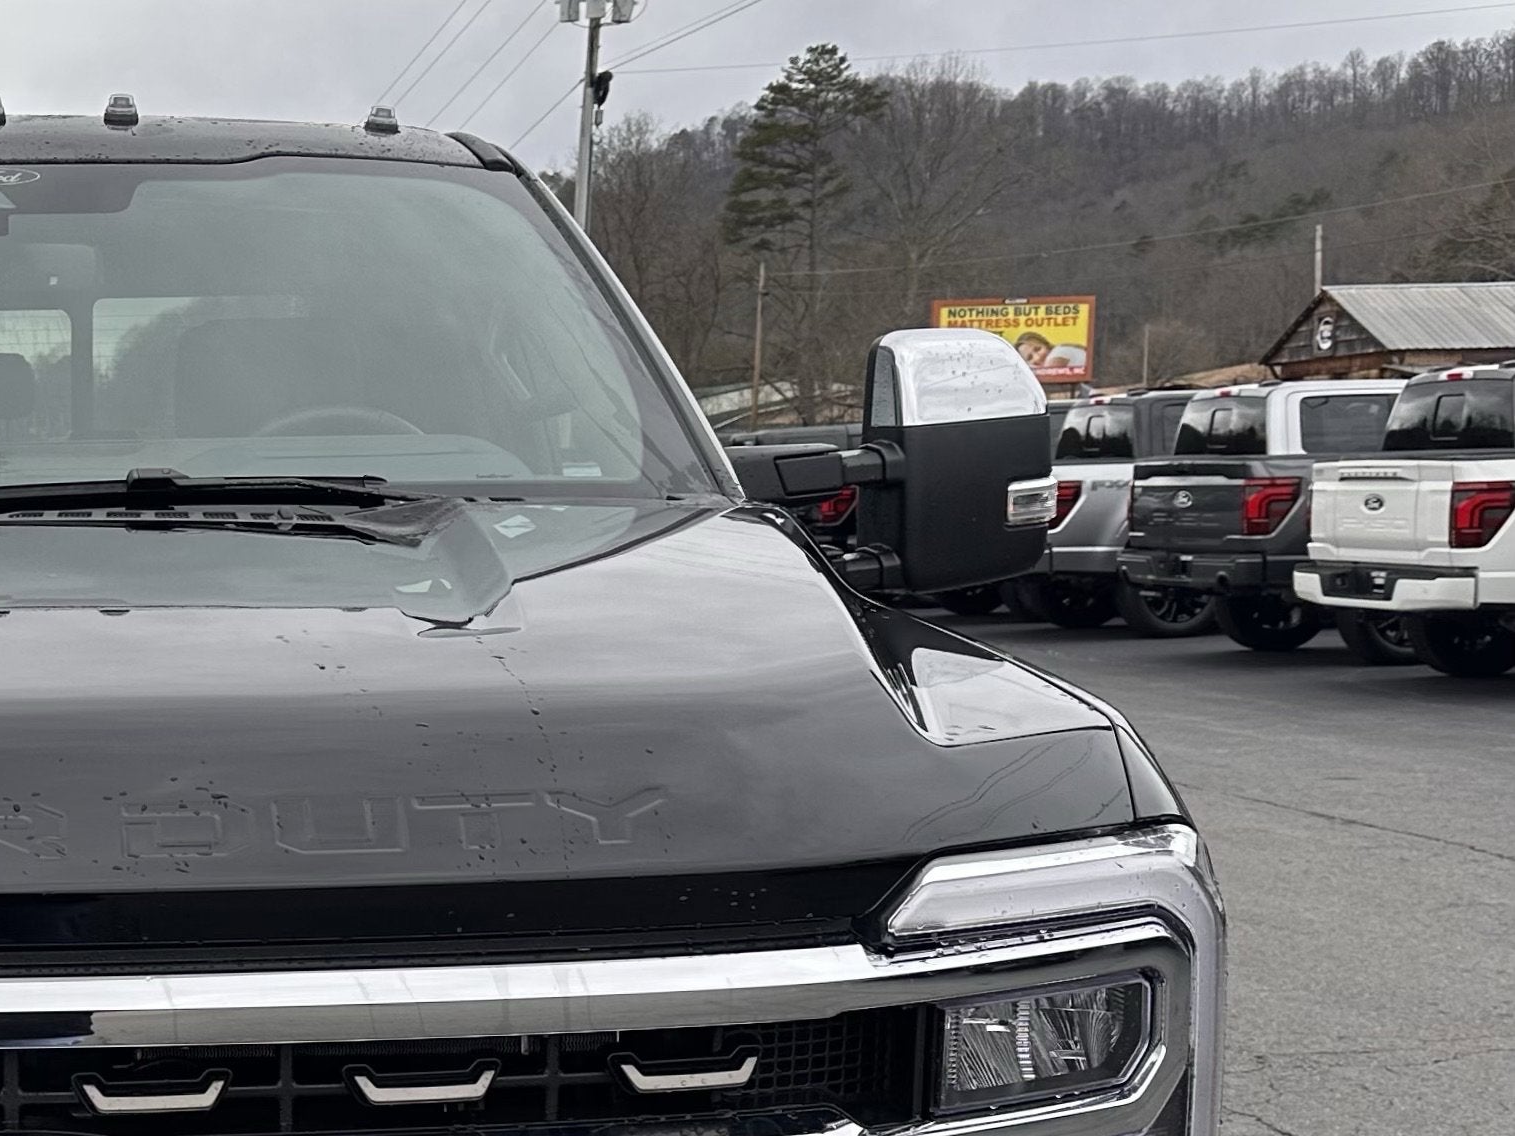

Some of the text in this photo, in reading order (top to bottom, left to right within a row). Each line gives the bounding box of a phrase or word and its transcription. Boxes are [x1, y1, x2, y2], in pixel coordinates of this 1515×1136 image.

[947, 304, 1080, 319] NOTHING BUT BEDS
[947, 315, 1079, 329] MATTRESS OUTLET
[119, 785, 667, 859] DUTY
